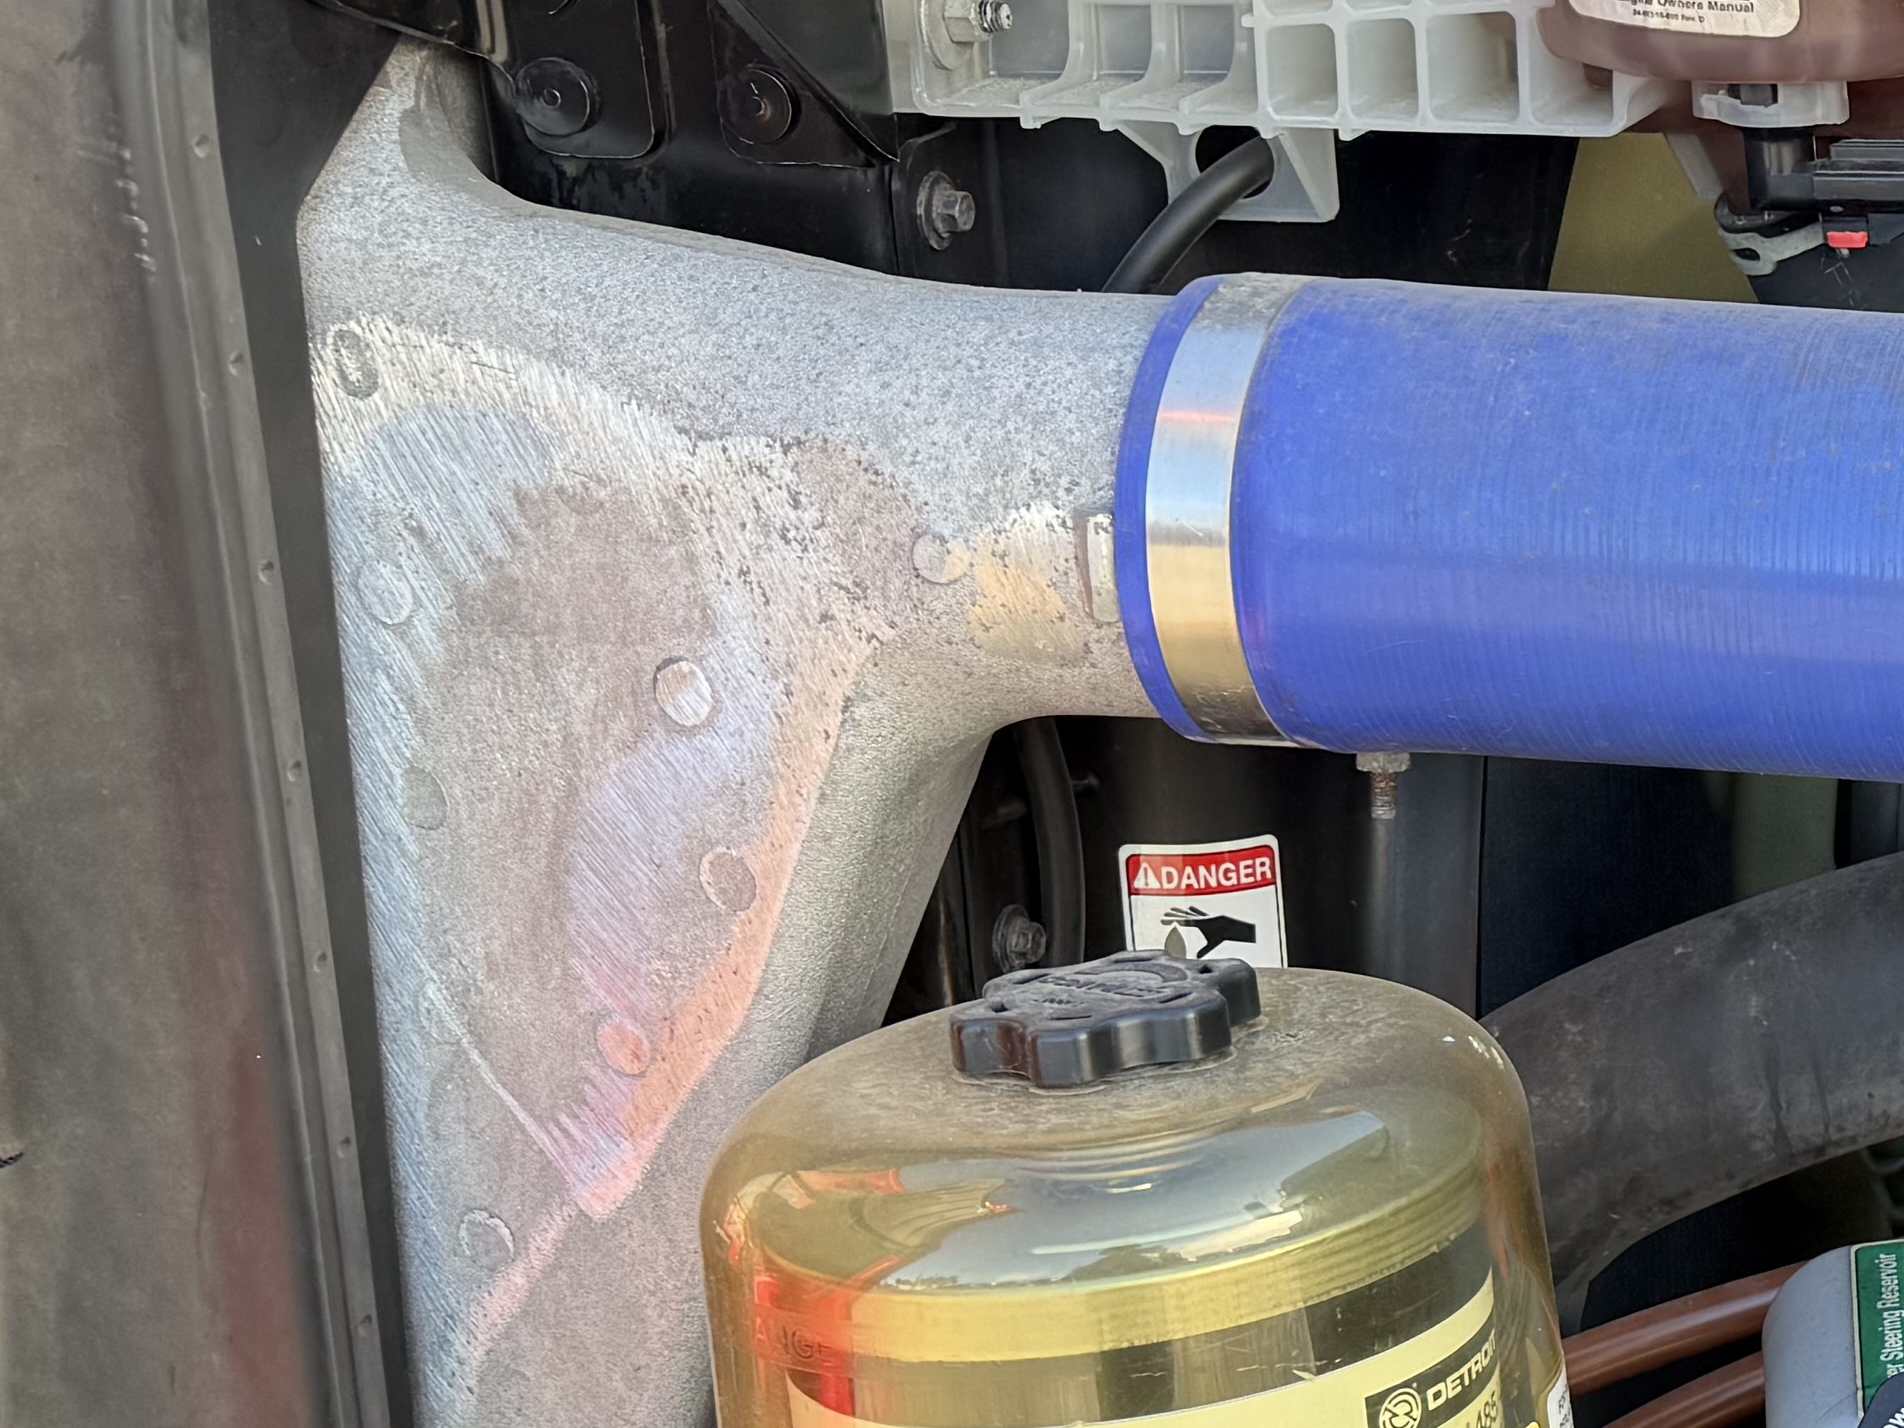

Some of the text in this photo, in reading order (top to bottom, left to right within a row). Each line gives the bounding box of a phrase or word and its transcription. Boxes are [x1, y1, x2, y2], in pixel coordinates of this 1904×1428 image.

[1161, 856, 1273, 890] DANGER
[1875, 1253, 1901, 1310] Reservoir
[1426, 1327, 1497, 1412] DETROIT
